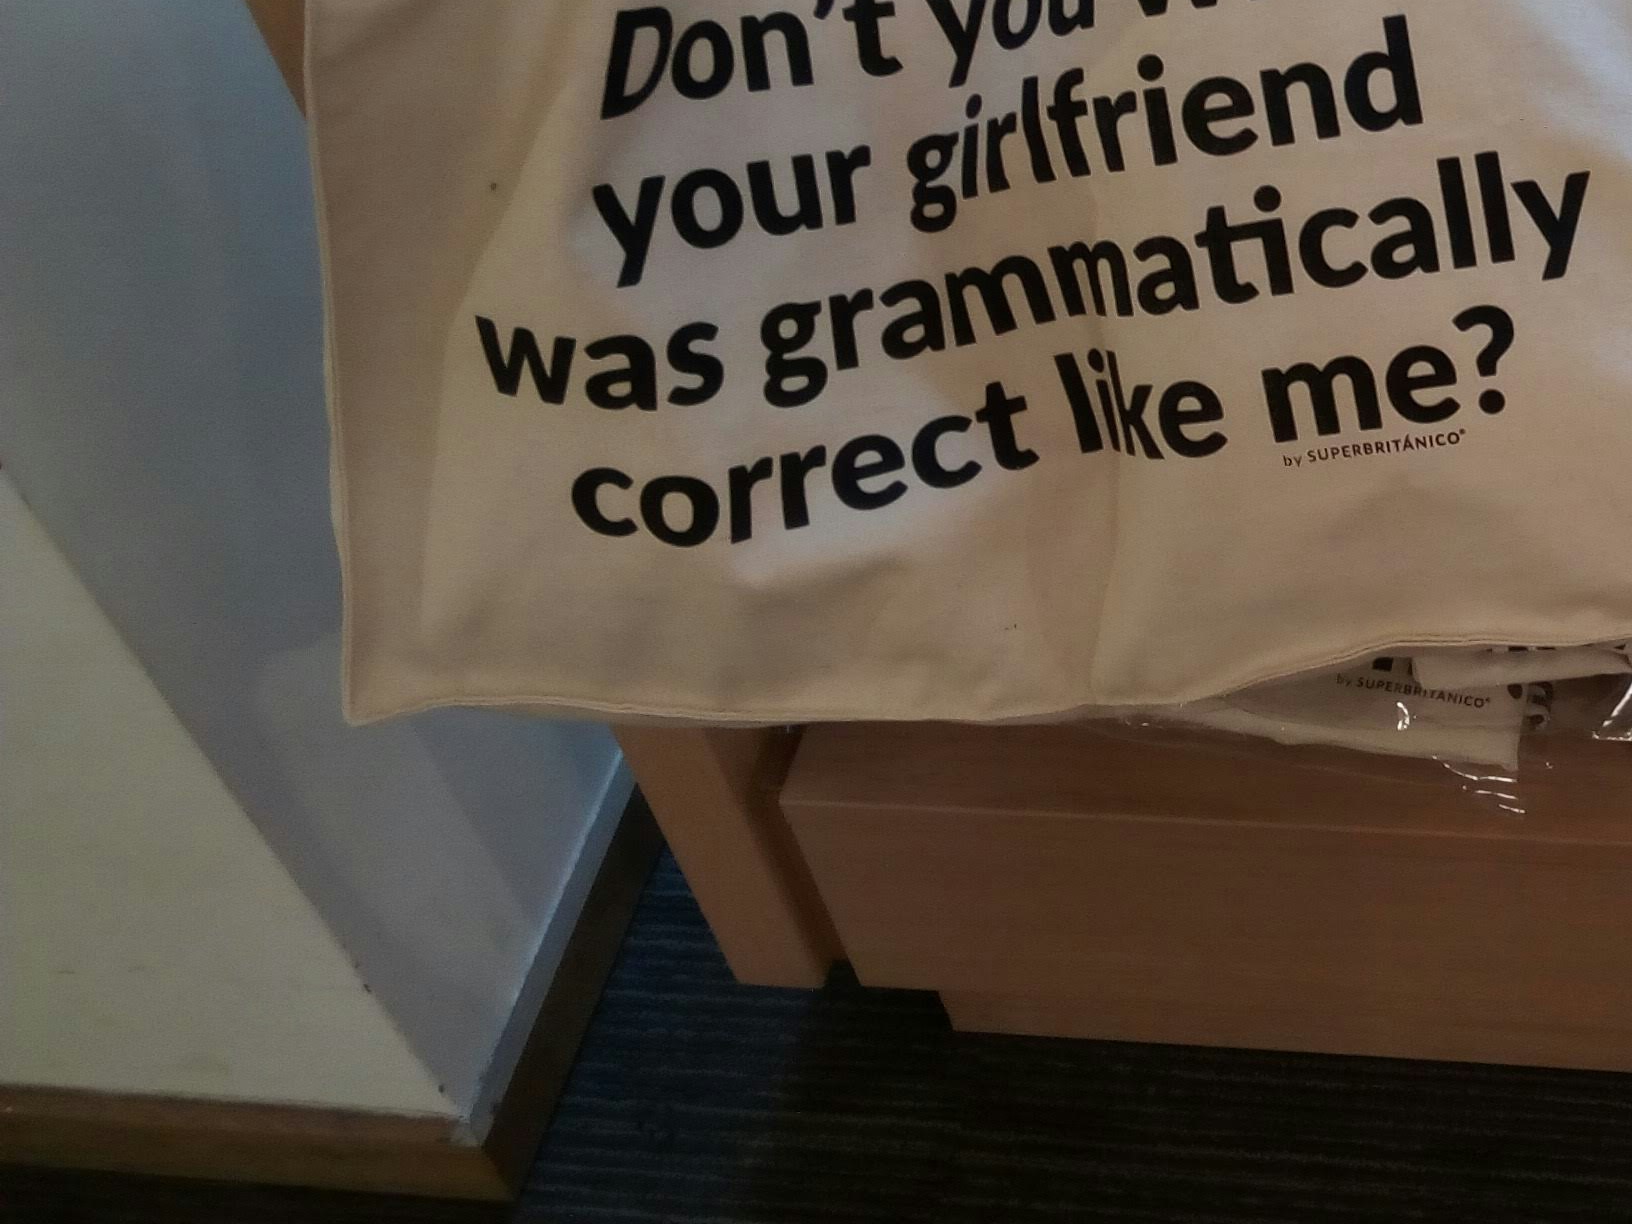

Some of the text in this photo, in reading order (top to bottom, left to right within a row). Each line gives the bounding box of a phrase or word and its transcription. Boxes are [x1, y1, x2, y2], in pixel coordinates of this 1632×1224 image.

[591, 15, 1422, 288] your girlfriend
[475, 152, 1590, 411] was grammatically
[572, 305, 1514, 547] correct like me?
[1282, 455, 1301, 468] by
